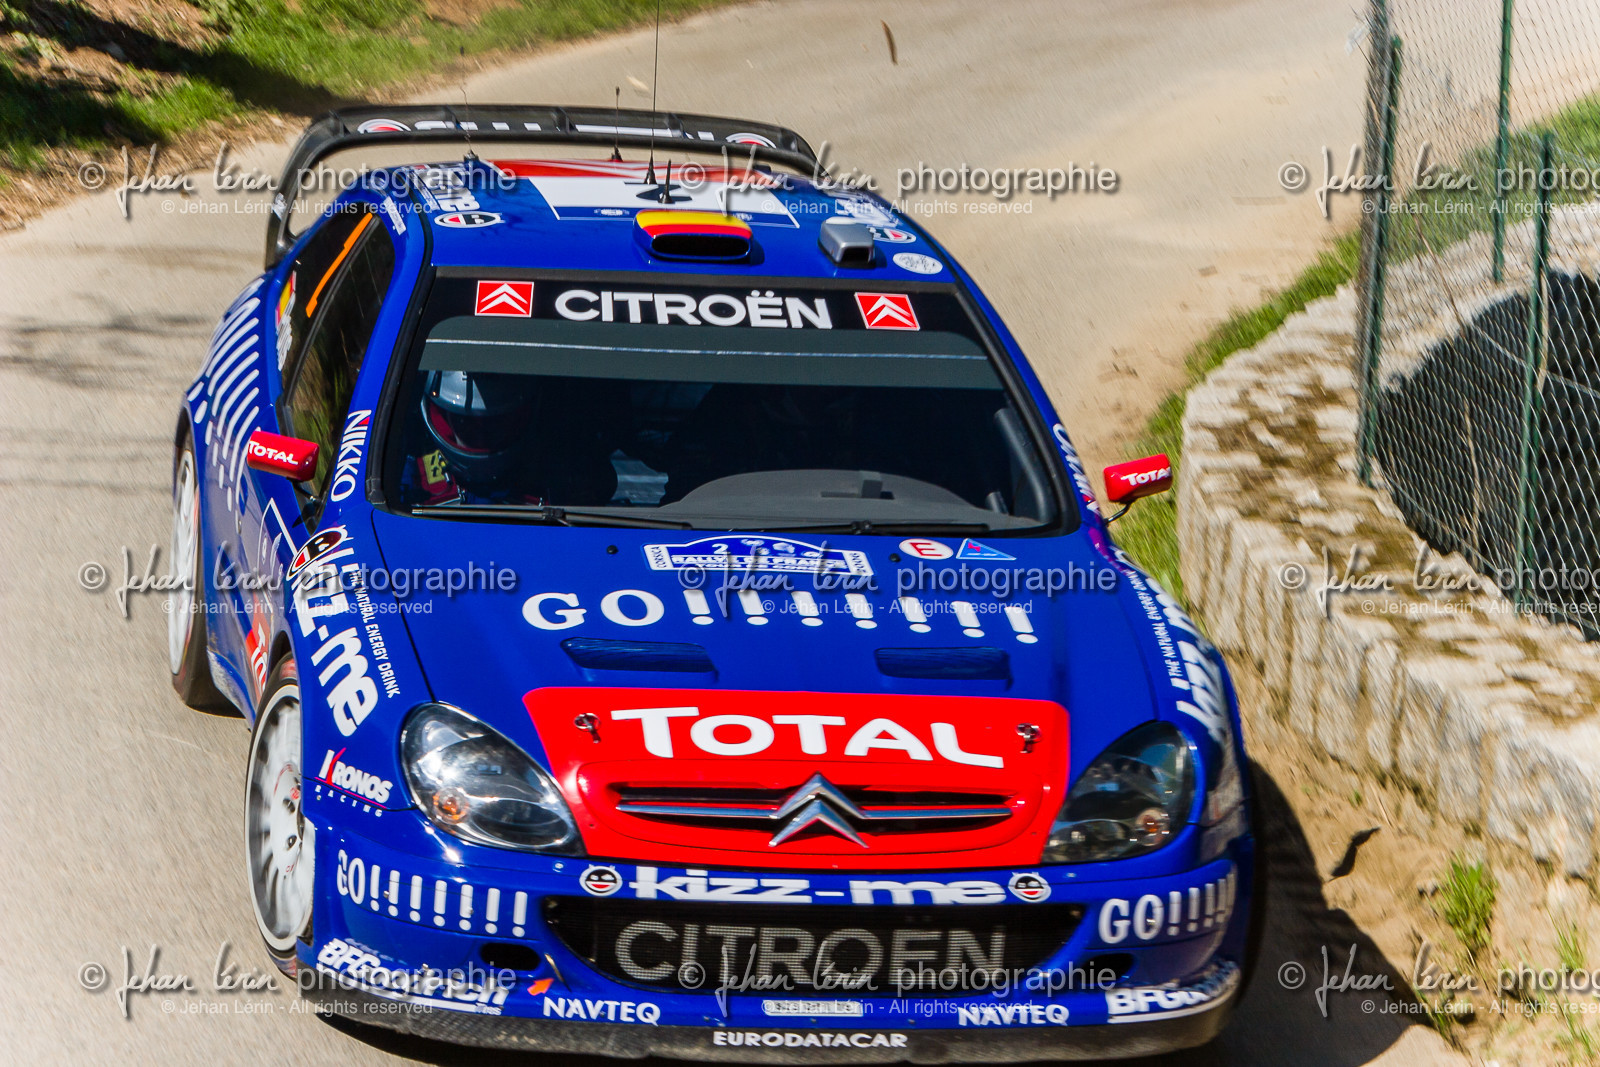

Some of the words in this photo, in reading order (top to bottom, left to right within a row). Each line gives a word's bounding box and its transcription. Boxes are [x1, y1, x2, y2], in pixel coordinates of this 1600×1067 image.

[555, 290, 832, 329] CITROËN
[249, 440, 299, 465] TOTAL
[330, 409, 372, 502] NIKKO
[1120, 467, 1171, 486] TOTA
[711, 543, 729, 555] 2
[349, 569, 364, 587] THE
[353, 587, 376, 624] NATURAL
[365, 623, 389, 661] ENERGY
[377, 662, 401, 699] DRINK
[611, 706, 1004, 769] TOTAL
[318, 747, 394, 804] KRONOS
[314, 784, 383, 818] RACING
[629, 866, 1007, 904] kizz-me
[543, 996, 661, 1027] NAVTEQ
[958, 1004, 1070, 1026] NAVTEQ
[712, 1030, 909, 1049] EURODATACAR
